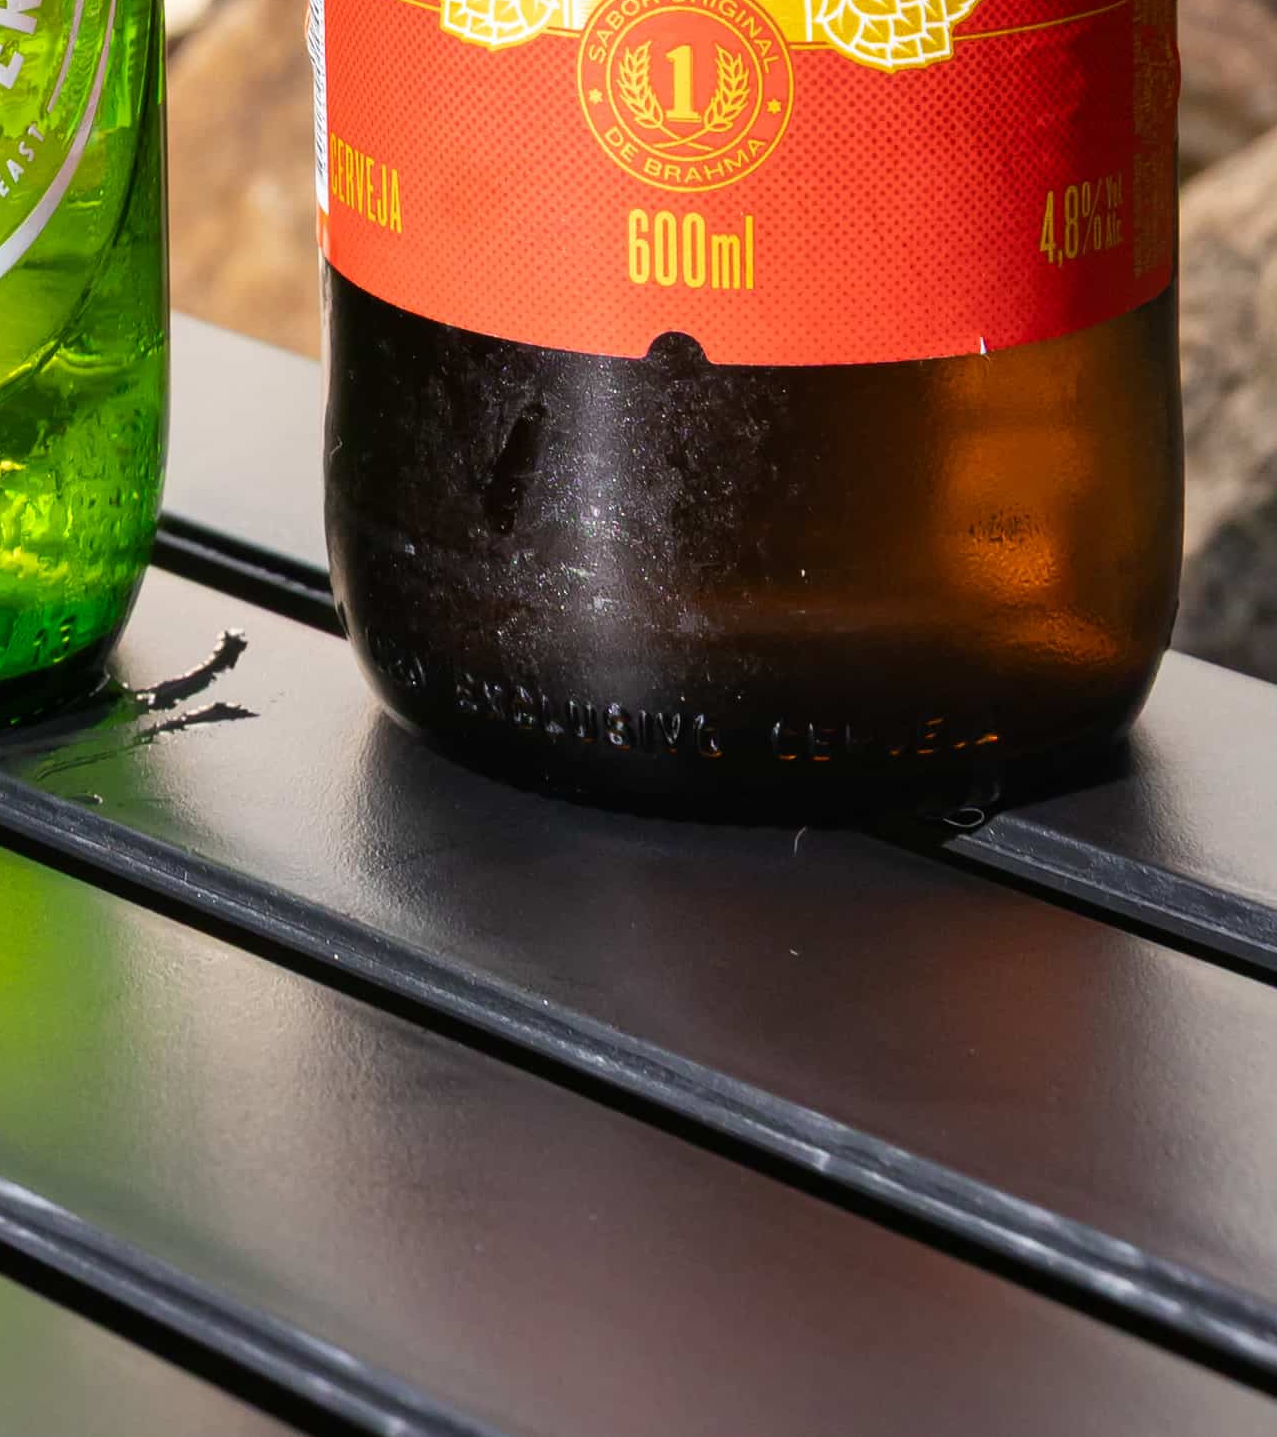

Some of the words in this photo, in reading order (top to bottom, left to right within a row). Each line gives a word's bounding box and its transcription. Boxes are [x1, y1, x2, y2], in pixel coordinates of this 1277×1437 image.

[665, 44, 702, 123] 1
[329, 129, 403, 237] CERVEJA
[604, 125, 639, 163] DE
[642, 137, 767, 184] BRAHMA
[627, 209, 756, 290] 600ml
[1039, 176, 1103, 269] 4,8%
